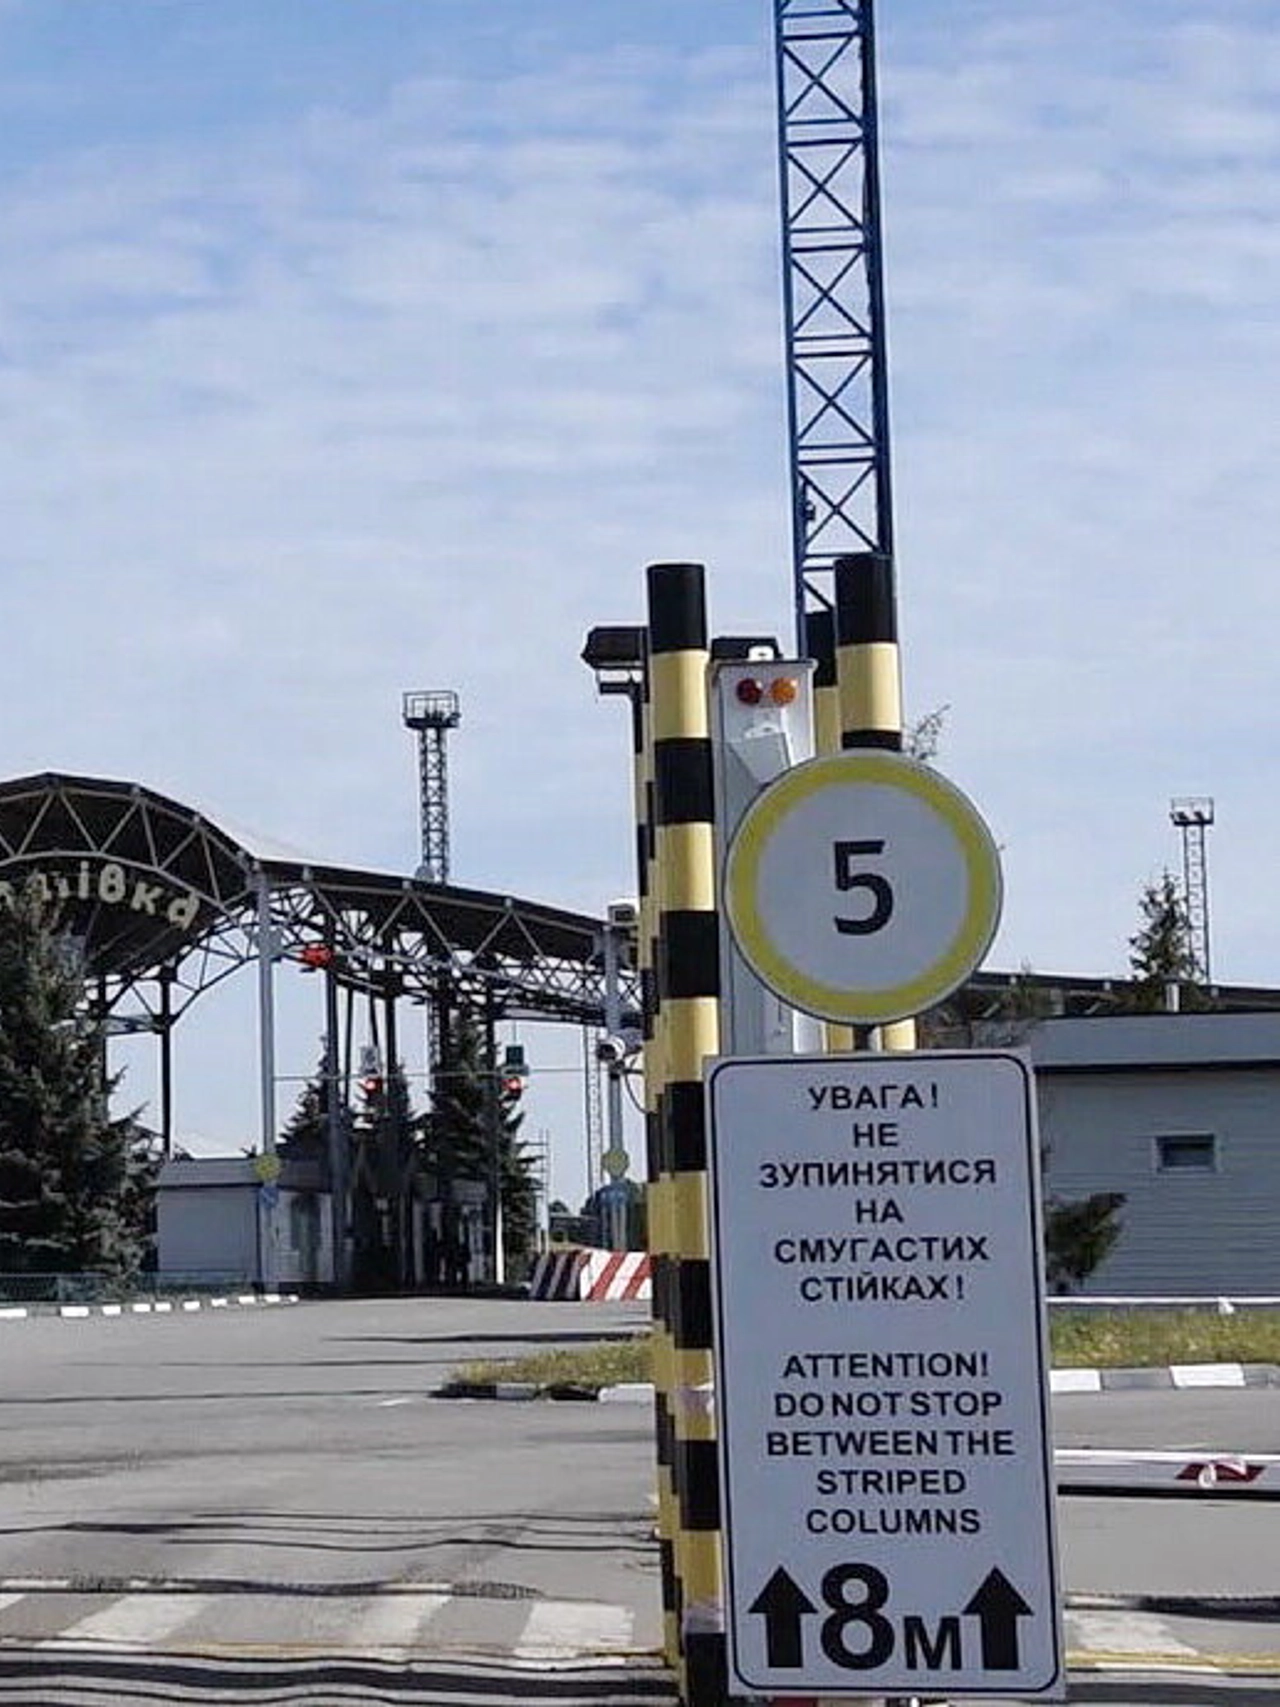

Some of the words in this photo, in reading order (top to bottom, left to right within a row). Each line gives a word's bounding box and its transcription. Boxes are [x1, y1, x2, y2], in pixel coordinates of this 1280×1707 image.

[833, 839, 894, 936] 5
[807, 1082, 938, 1111] УВАГА!
[852, 1122, 899, 1149] НЕ
[759, 1159, 997, 1189] ЗУПИНЯТИСЯ
[855, 1198, 904, 1224] НА
[774, 1236, 990, 1265] СМУГАСТИХ
[800, 1271, 964, 1302] СТІЙКАХ!
[782, 1352, 988, 1379] ATTENTION!
[774, 1392, 825, 1418] DO
[831, 1391, 904, 1418] NOT
[910, 1390, 1002, 1417] STOP
[766, 1430, 938, 1456] BETWEEN
[943, 1429, 1016, 1456] THE
[816, 1469, 967, 1496] STRIPED
[806, 1508, 981, 1535] COLUMNS
